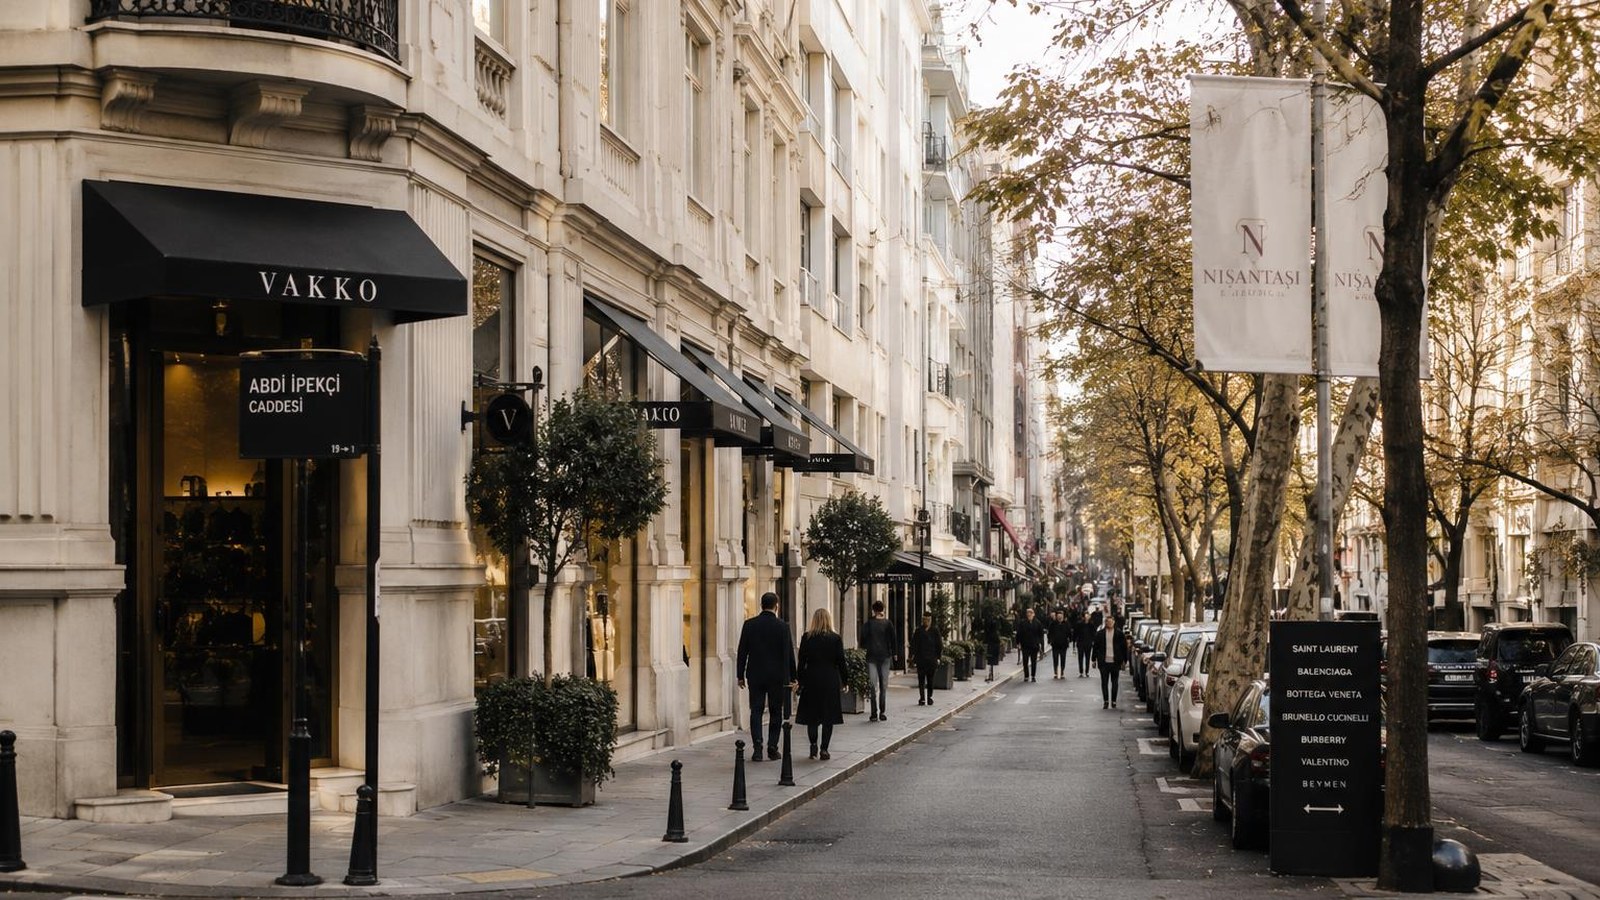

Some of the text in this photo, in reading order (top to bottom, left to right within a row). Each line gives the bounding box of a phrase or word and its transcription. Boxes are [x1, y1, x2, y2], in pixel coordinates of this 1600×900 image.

[1240, 224, 1264, 257] N
[258, 271, 377, 302] VAKKO
[249, 373, 340, 396] ABDİ İPEKÇİ
[249, 397, 303, 413] CADDESİ
[499, 409, 517, 431] V
[331, 444, 340, 454] 19
[1292, 644, 1358, 653] SAINT LAURENT
[1297, 667, 1352, 676] BALENCIAGA
[1286, 689, 1362, 699] BOTTEGA VENETA
[1282, 712, 1369, 722] BRUNELLO CUCINELLI
[1301, 735, 1347, 744] BURBERRY
[1301, 758, 1350, 767] VALENTINO
[1302, 780, 1347, 788] BEYMEN
